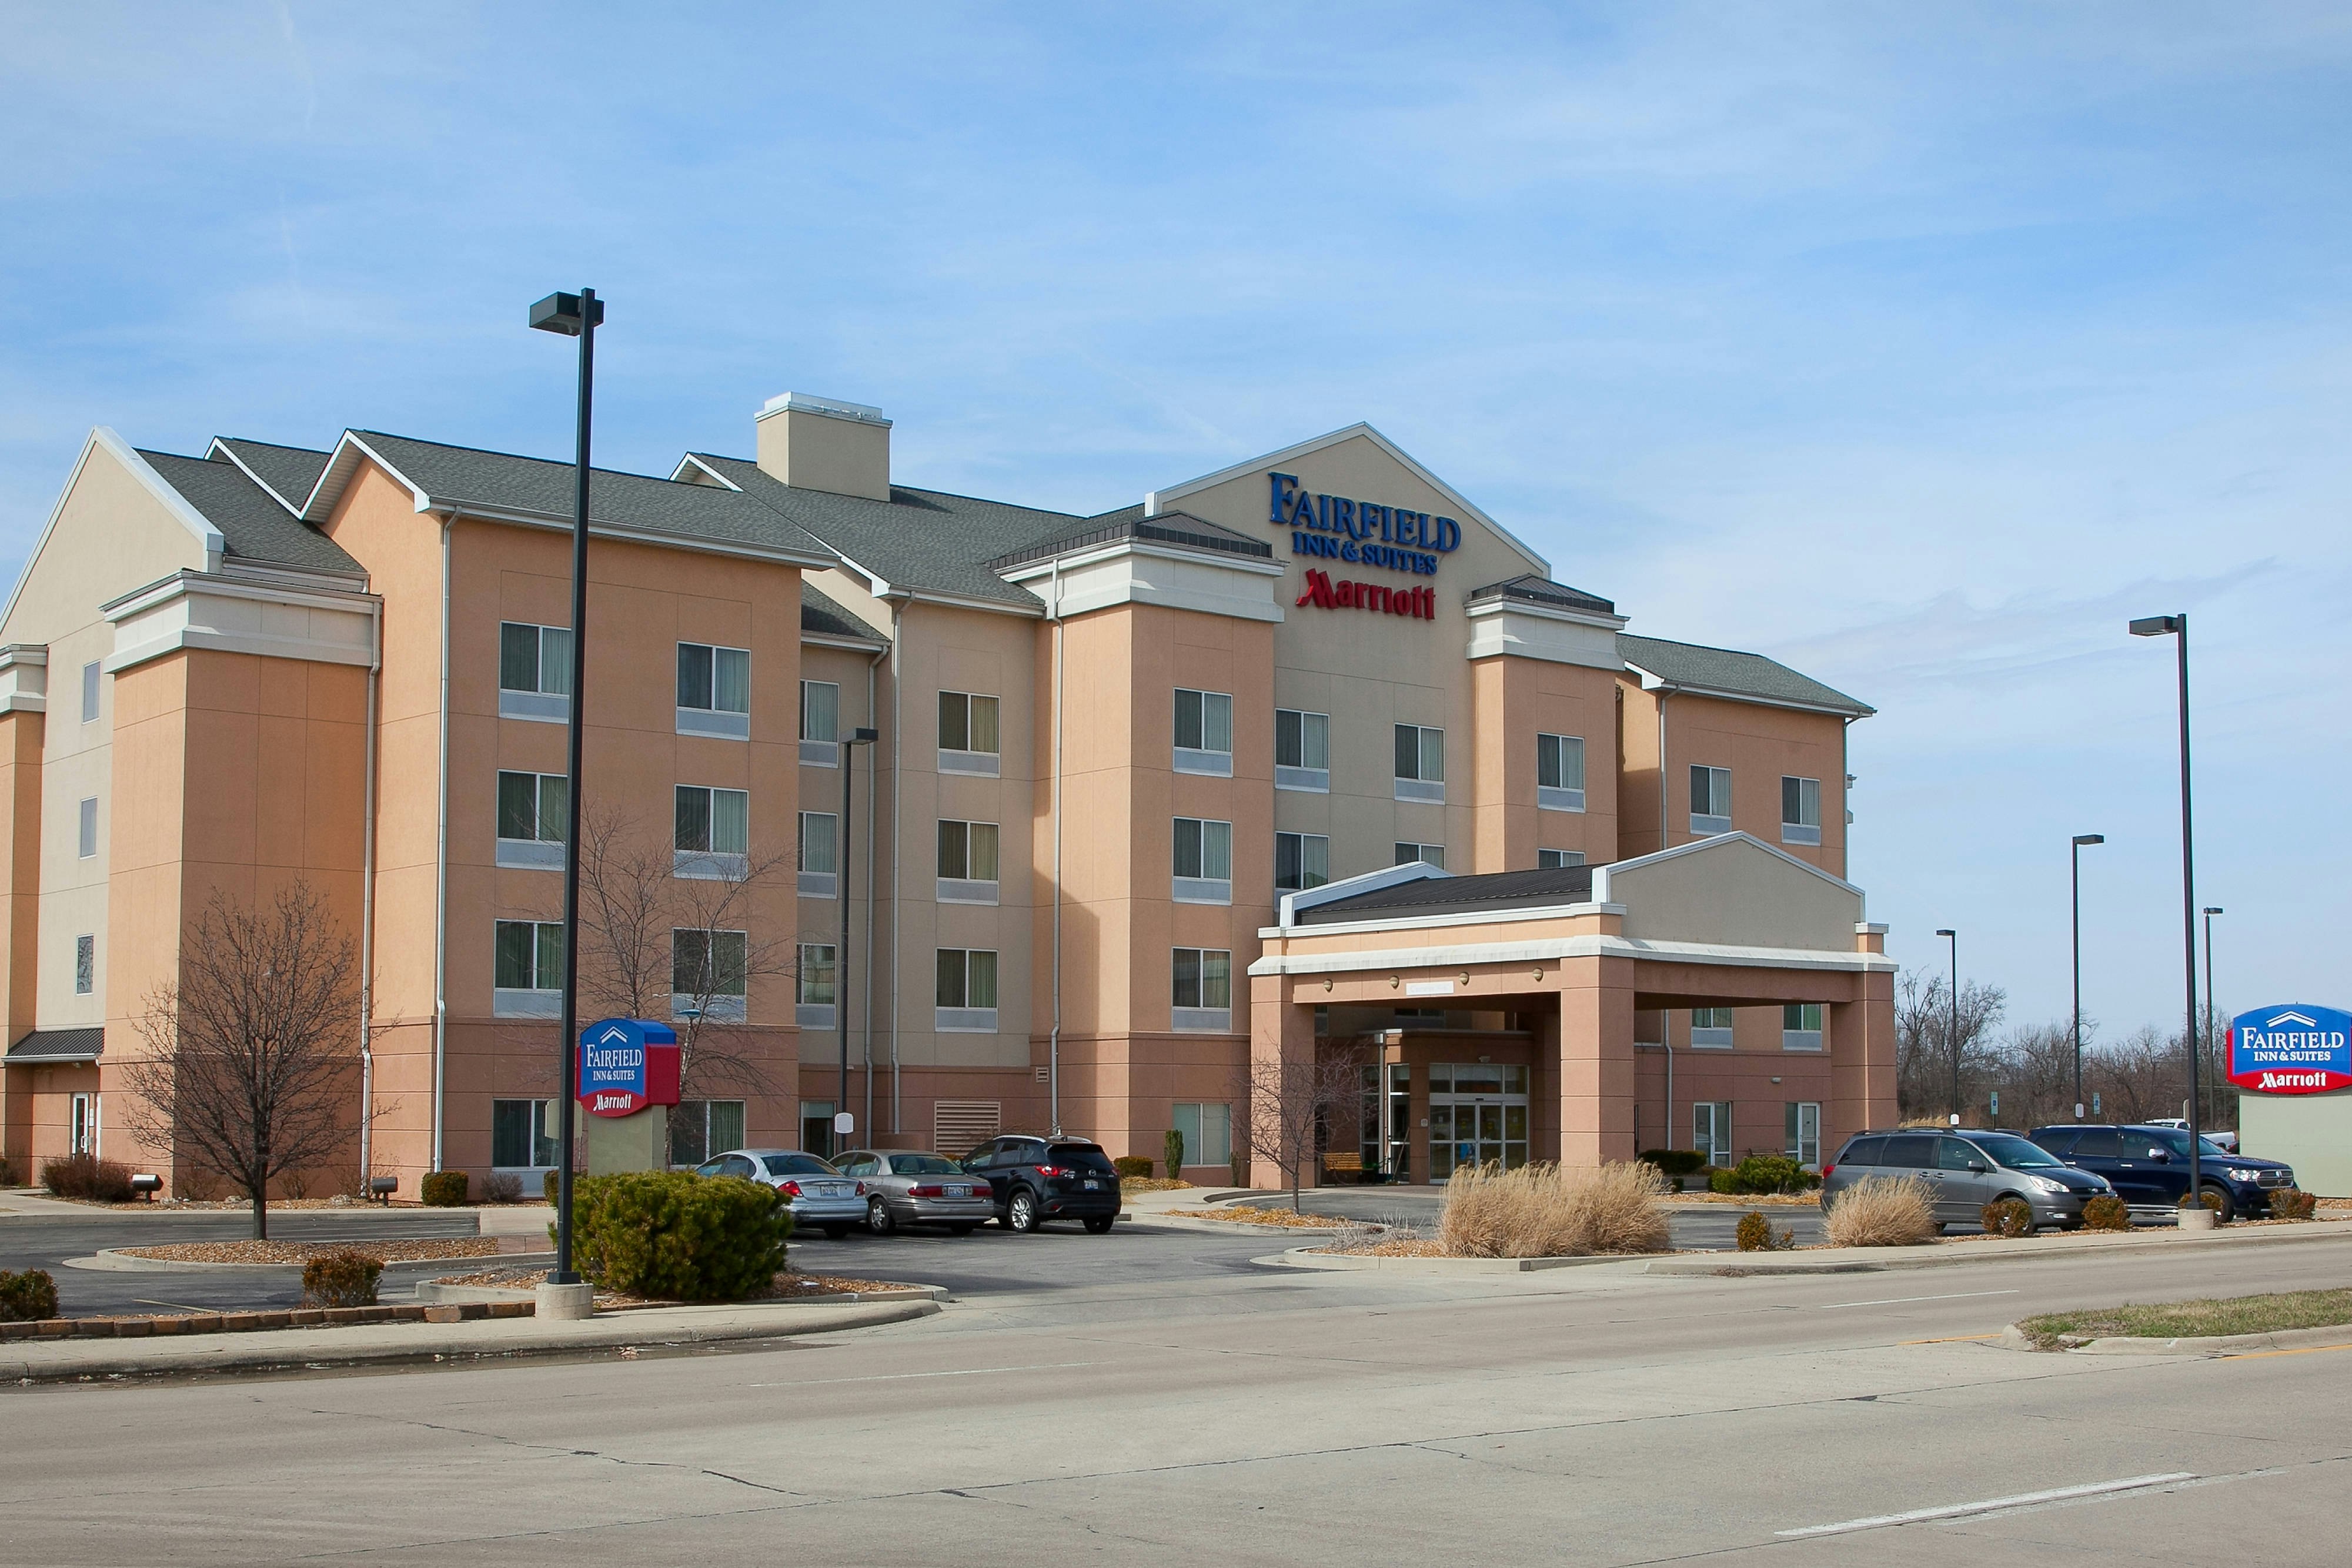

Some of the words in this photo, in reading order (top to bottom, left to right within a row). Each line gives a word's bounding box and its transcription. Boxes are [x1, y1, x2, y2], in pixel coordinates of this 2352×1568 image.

[1268, 472, 1461, 552] FAIRFIELD
[1292, 531, 1340, 559] INN
[1341, 540, 1360, 563] &
[1362, 543, 1438, 576] SUITES
[1295, 567, 1436, 620] Marriott
[2241, 1027, 2344, 1051] FAIRFIELD
[586, 1044, 643, 1069] FAIRFIELD
[2253, 1051, 2278, 1061] INN
[2278, 1051, 2289, 1061] &
[2290, 1051, 2331, 1061] SUITES
[593, 1070, 606, 1081] INN
[613, 1070, 635, 1081] SUITES
[2258, 1072, 2327, 1089] Marriott
[593, 1094, 632, 1112] Marriott
